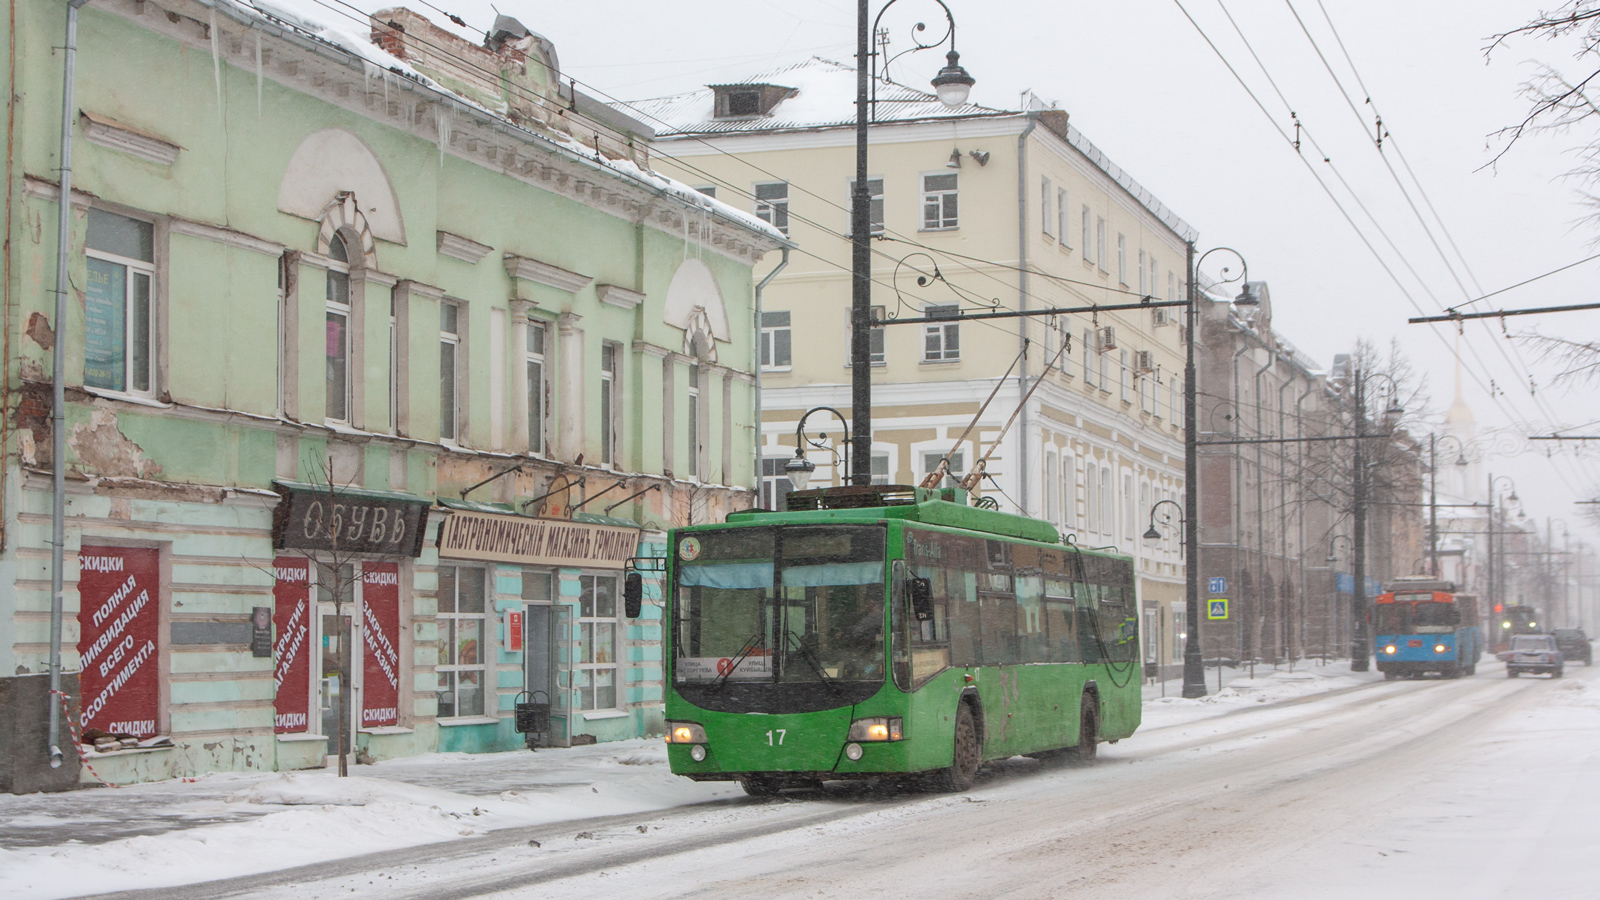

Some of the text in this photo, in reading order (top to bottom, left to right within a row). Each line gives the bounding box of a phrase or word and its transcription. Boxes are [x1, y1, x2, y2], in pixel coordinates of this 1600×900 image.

[303, 500, 405, 543] ОБУВЬ
[545, 525, 590, 559] МАГАЗИНЪ
[78, 556, 123, 573] СКИДКИ
[364, 572, 397, 586] СКИДКИ
[92, 574, 136, 628] ПОЛНАЯ
[79, 589, 149, 672] ЛИКВИДАЦИЯ
[275, 599, 305, 664] КРЫТИЕ
[363, 600, 397, 666] ЗАКРЫТИЕ
[99, 635, 133, 678] ВСЕГО
[363, 625, 398, 690] МАГАЗИНА
[721, 660, 728, 675] 1
[80, 640, 155, 727] ССОРТИМЕНТА
[109, 720, 155, 737] СКИДКИ
[364, 708, 397, 722] СКИДКИ
[765, 728, 787, 746] 17
